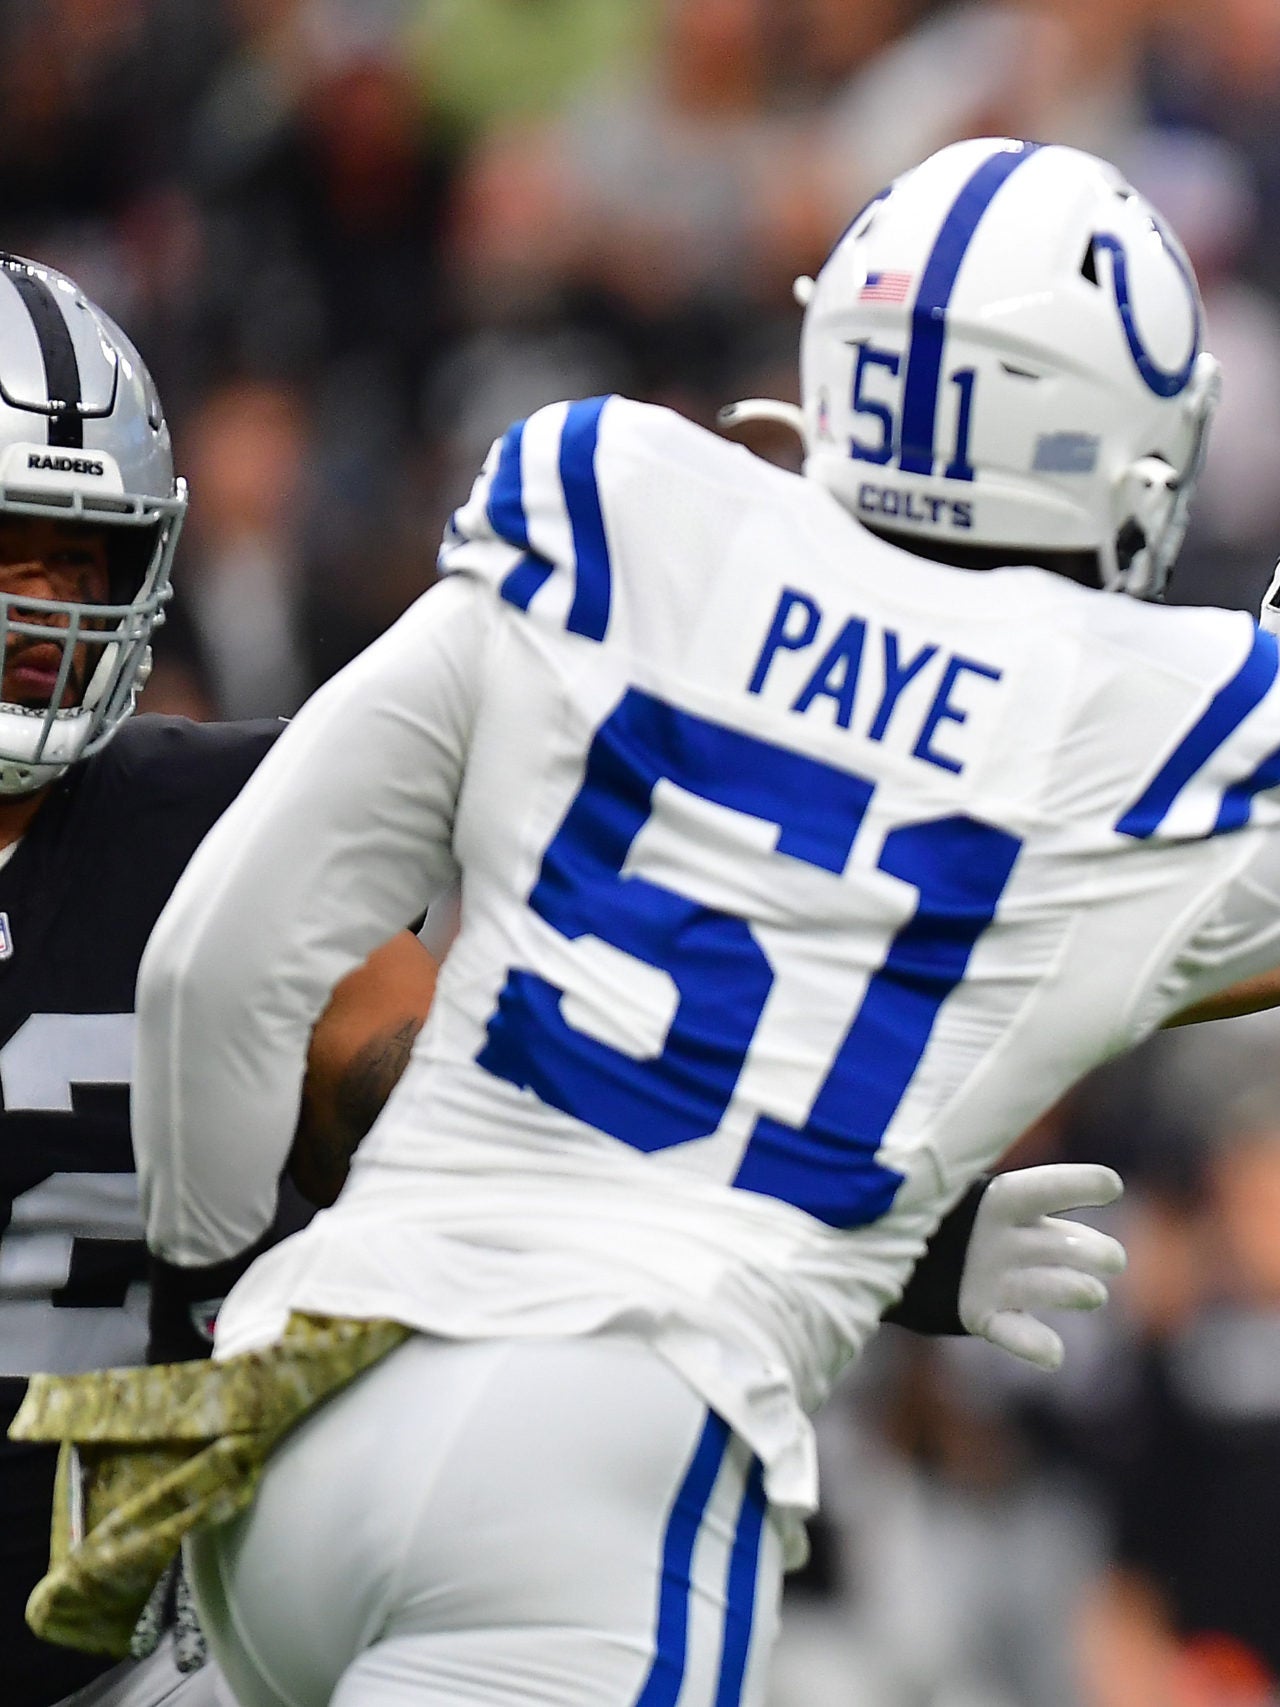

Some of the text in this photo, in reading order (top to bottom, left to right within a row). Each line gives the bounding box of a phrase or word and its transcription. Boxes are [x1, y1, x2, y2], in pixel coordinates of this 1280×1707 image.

[28, 454, 104, 476] RAIDERS
[849, 343, 976, 482] 51
[858, 484, 974, 530] COLTS
[746, 585, 1003, 775] PAYE
[474, 684, 1024, 1230] 51
